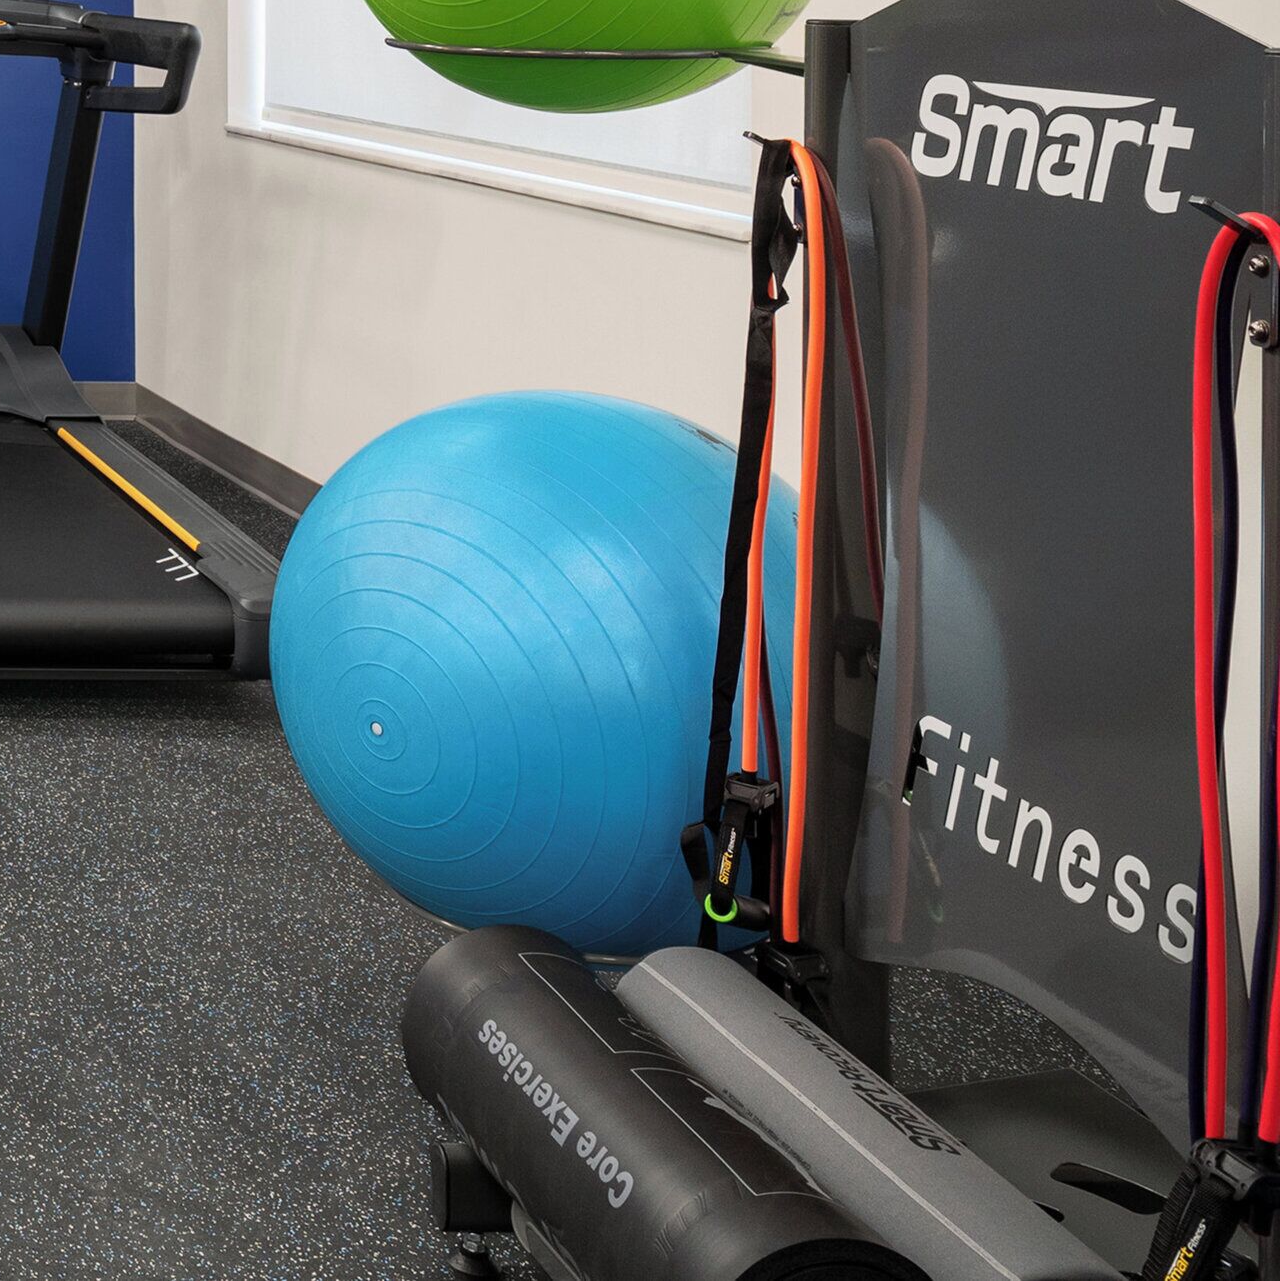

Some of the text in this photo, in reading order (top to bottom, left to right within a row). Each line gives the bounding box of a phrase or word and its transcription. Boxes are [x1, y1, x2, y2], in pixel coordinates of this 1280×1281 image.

[911, 74, 1195, 214] Smart
[719, 851, 734, 885] Smart
[478, 1019, 634, 1209] Core Exercises
